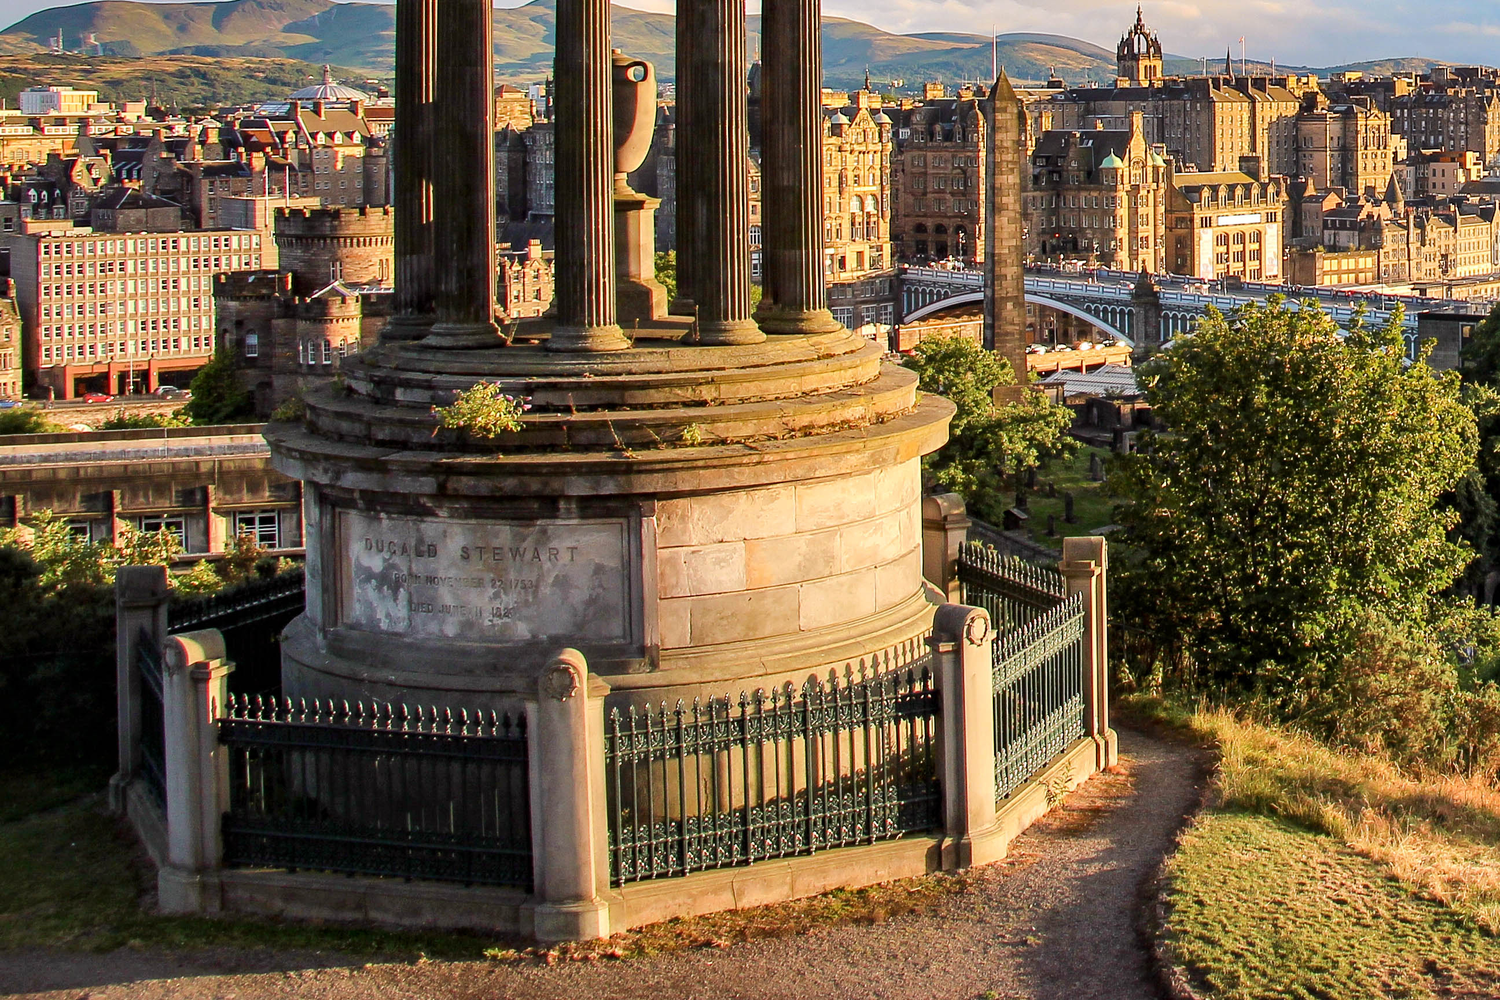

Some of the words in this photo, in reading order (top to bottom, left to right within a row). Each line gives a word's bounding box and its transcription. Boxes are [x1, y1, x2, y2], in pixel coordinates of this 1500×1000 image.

[364, 537, 438, 558] DUGALD
[460, 546, 578, 561] STEWART
[426, 575, 485, 588] NOVEMBER
[410, 601, 434, 613] DIED
